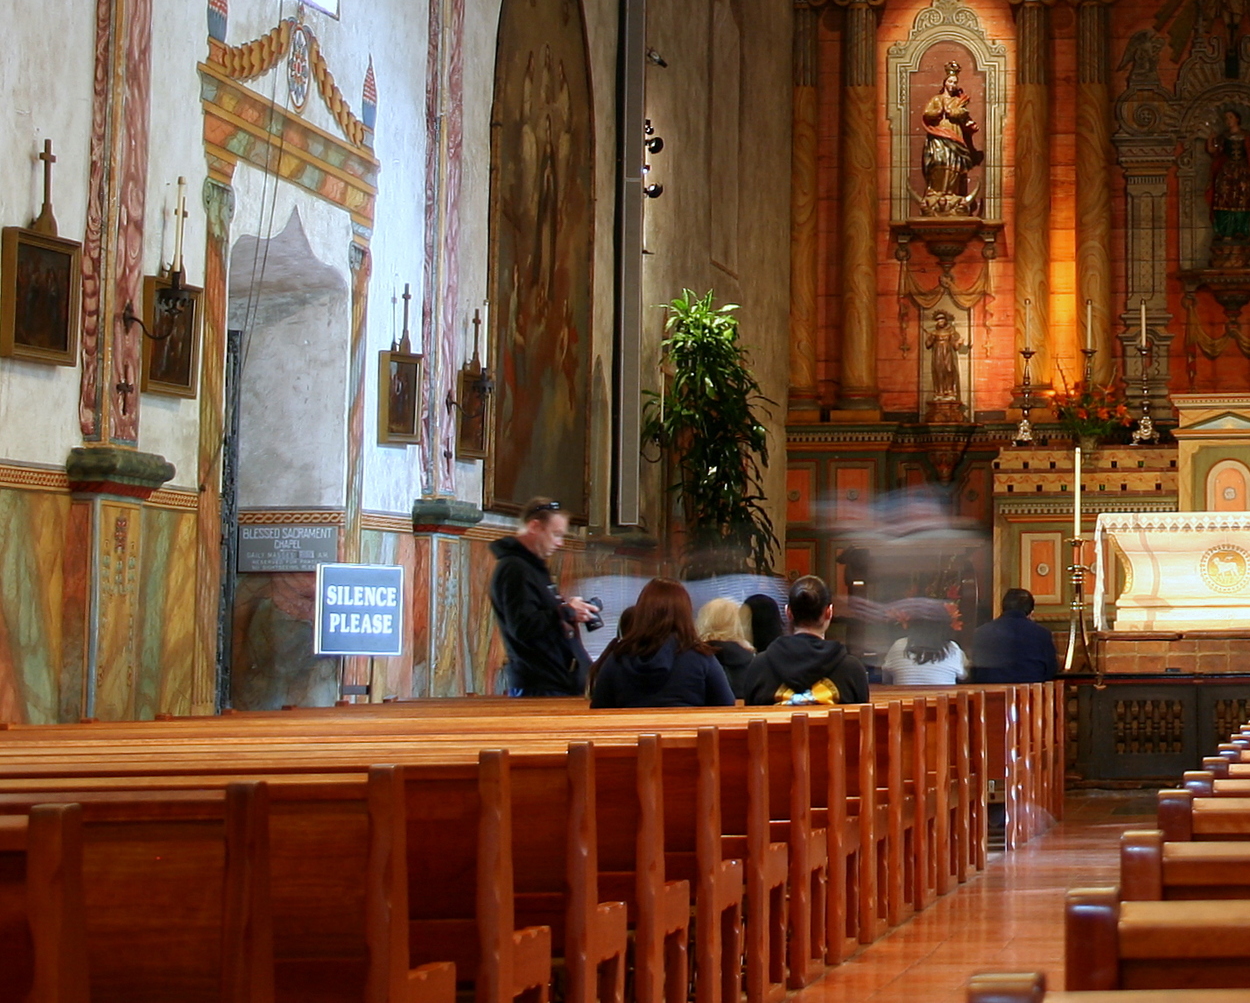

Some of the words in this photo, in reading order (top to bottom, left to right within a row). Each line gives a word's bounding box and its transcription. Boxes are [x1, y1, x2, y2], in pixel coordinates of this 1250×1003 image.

[243, 528, 280, 539] BLESSED
[281, 527, 332, 539] SACRAMENT
[274, 539, 301, 549] CHAPEL
[326, 585, 397, 607] SILENCE
[329, 613, 393, 634] PLEASE
